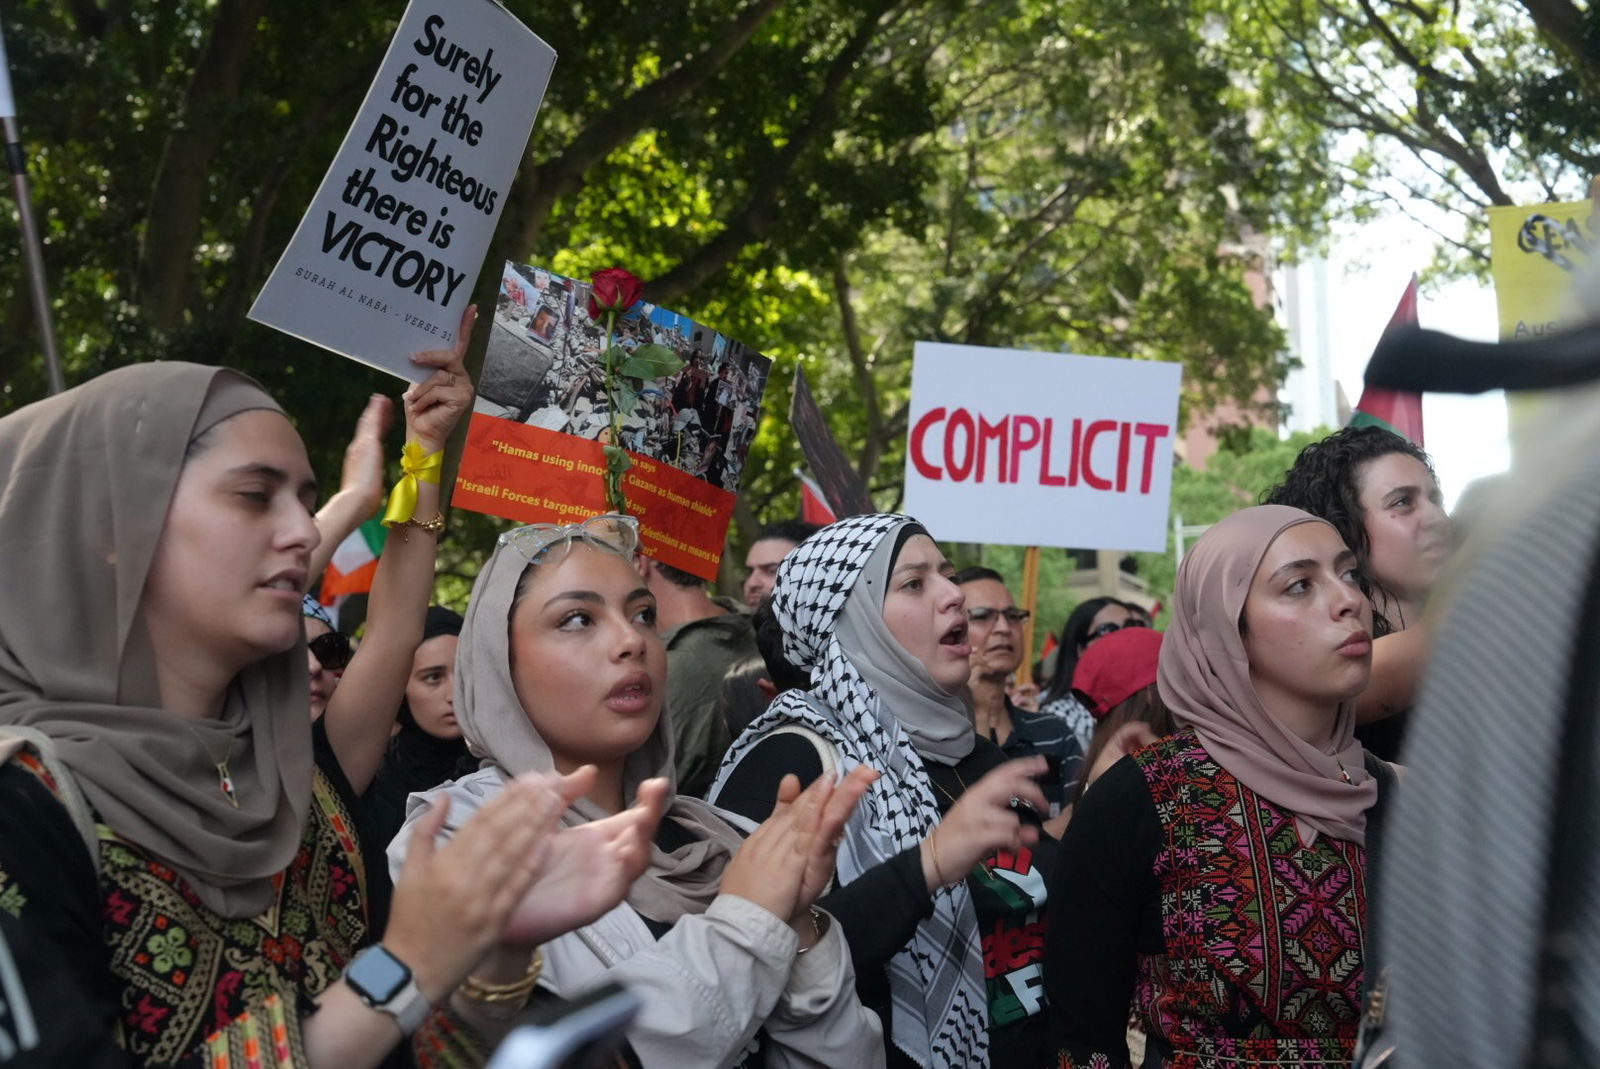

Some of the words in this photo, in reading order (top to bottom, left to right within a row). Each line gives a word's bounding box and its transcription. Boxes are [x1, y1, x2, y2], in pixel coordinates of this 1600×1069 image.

[413, 14, 502, 104] Surely
[390, 63, 441, 119] for
[440, 96, 483, 147] the
[365, 113, 498, 216] Righteous
[341, 168, 427, 236] there
[428, 206, 455, 249] is
[295, 267, 336, 291] SURAH
[339, 286, 353, 299] AL
[404, 313, 439, 335] VERSE
[321, 210, 466, 308] VICTORY
[492, 440, 539, 461] "Hamas
[542, 453, 574, 471] using
[628, 474, 657, 494] Gazans
[658, 487, 667, 497] as
[667, 488, 690, 509] human
[640, 461, 656, 473] says
[910, 407, 1169, 494] COMPLICIT
[456, 477, 499, 497] "Israeli
[501, 489, 541, 507] Forces
[678, 542, 688, 552] as
[687, 545, 711, 562] means
[711, 553, 720, 564] to
[631, 503, 646, 515] says
